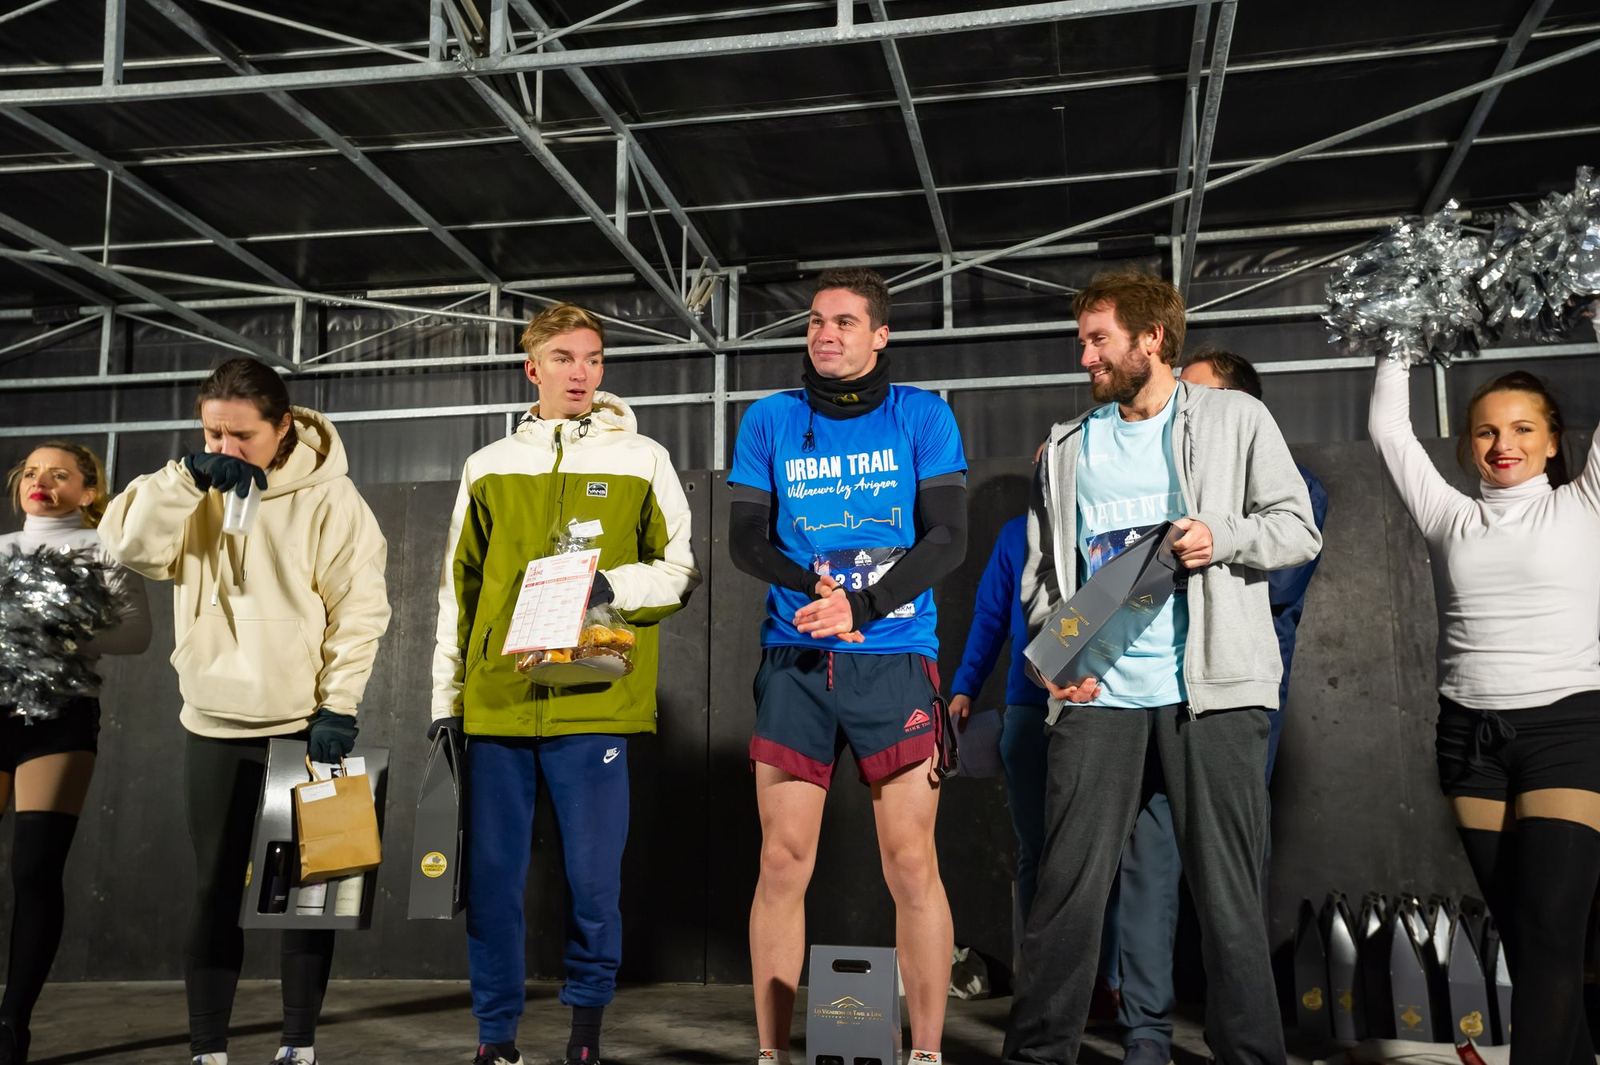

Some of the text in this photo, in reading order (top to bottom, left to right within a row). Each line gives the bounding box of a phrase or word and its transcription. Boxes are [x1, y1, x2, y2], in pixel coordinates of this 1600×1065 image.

[785, 448, 899, 482] URBAN TRAIL
[787, 477, 898, 500] Villeneuve lez Avignon
[1083, 492, 1185, 528] VALENCI
